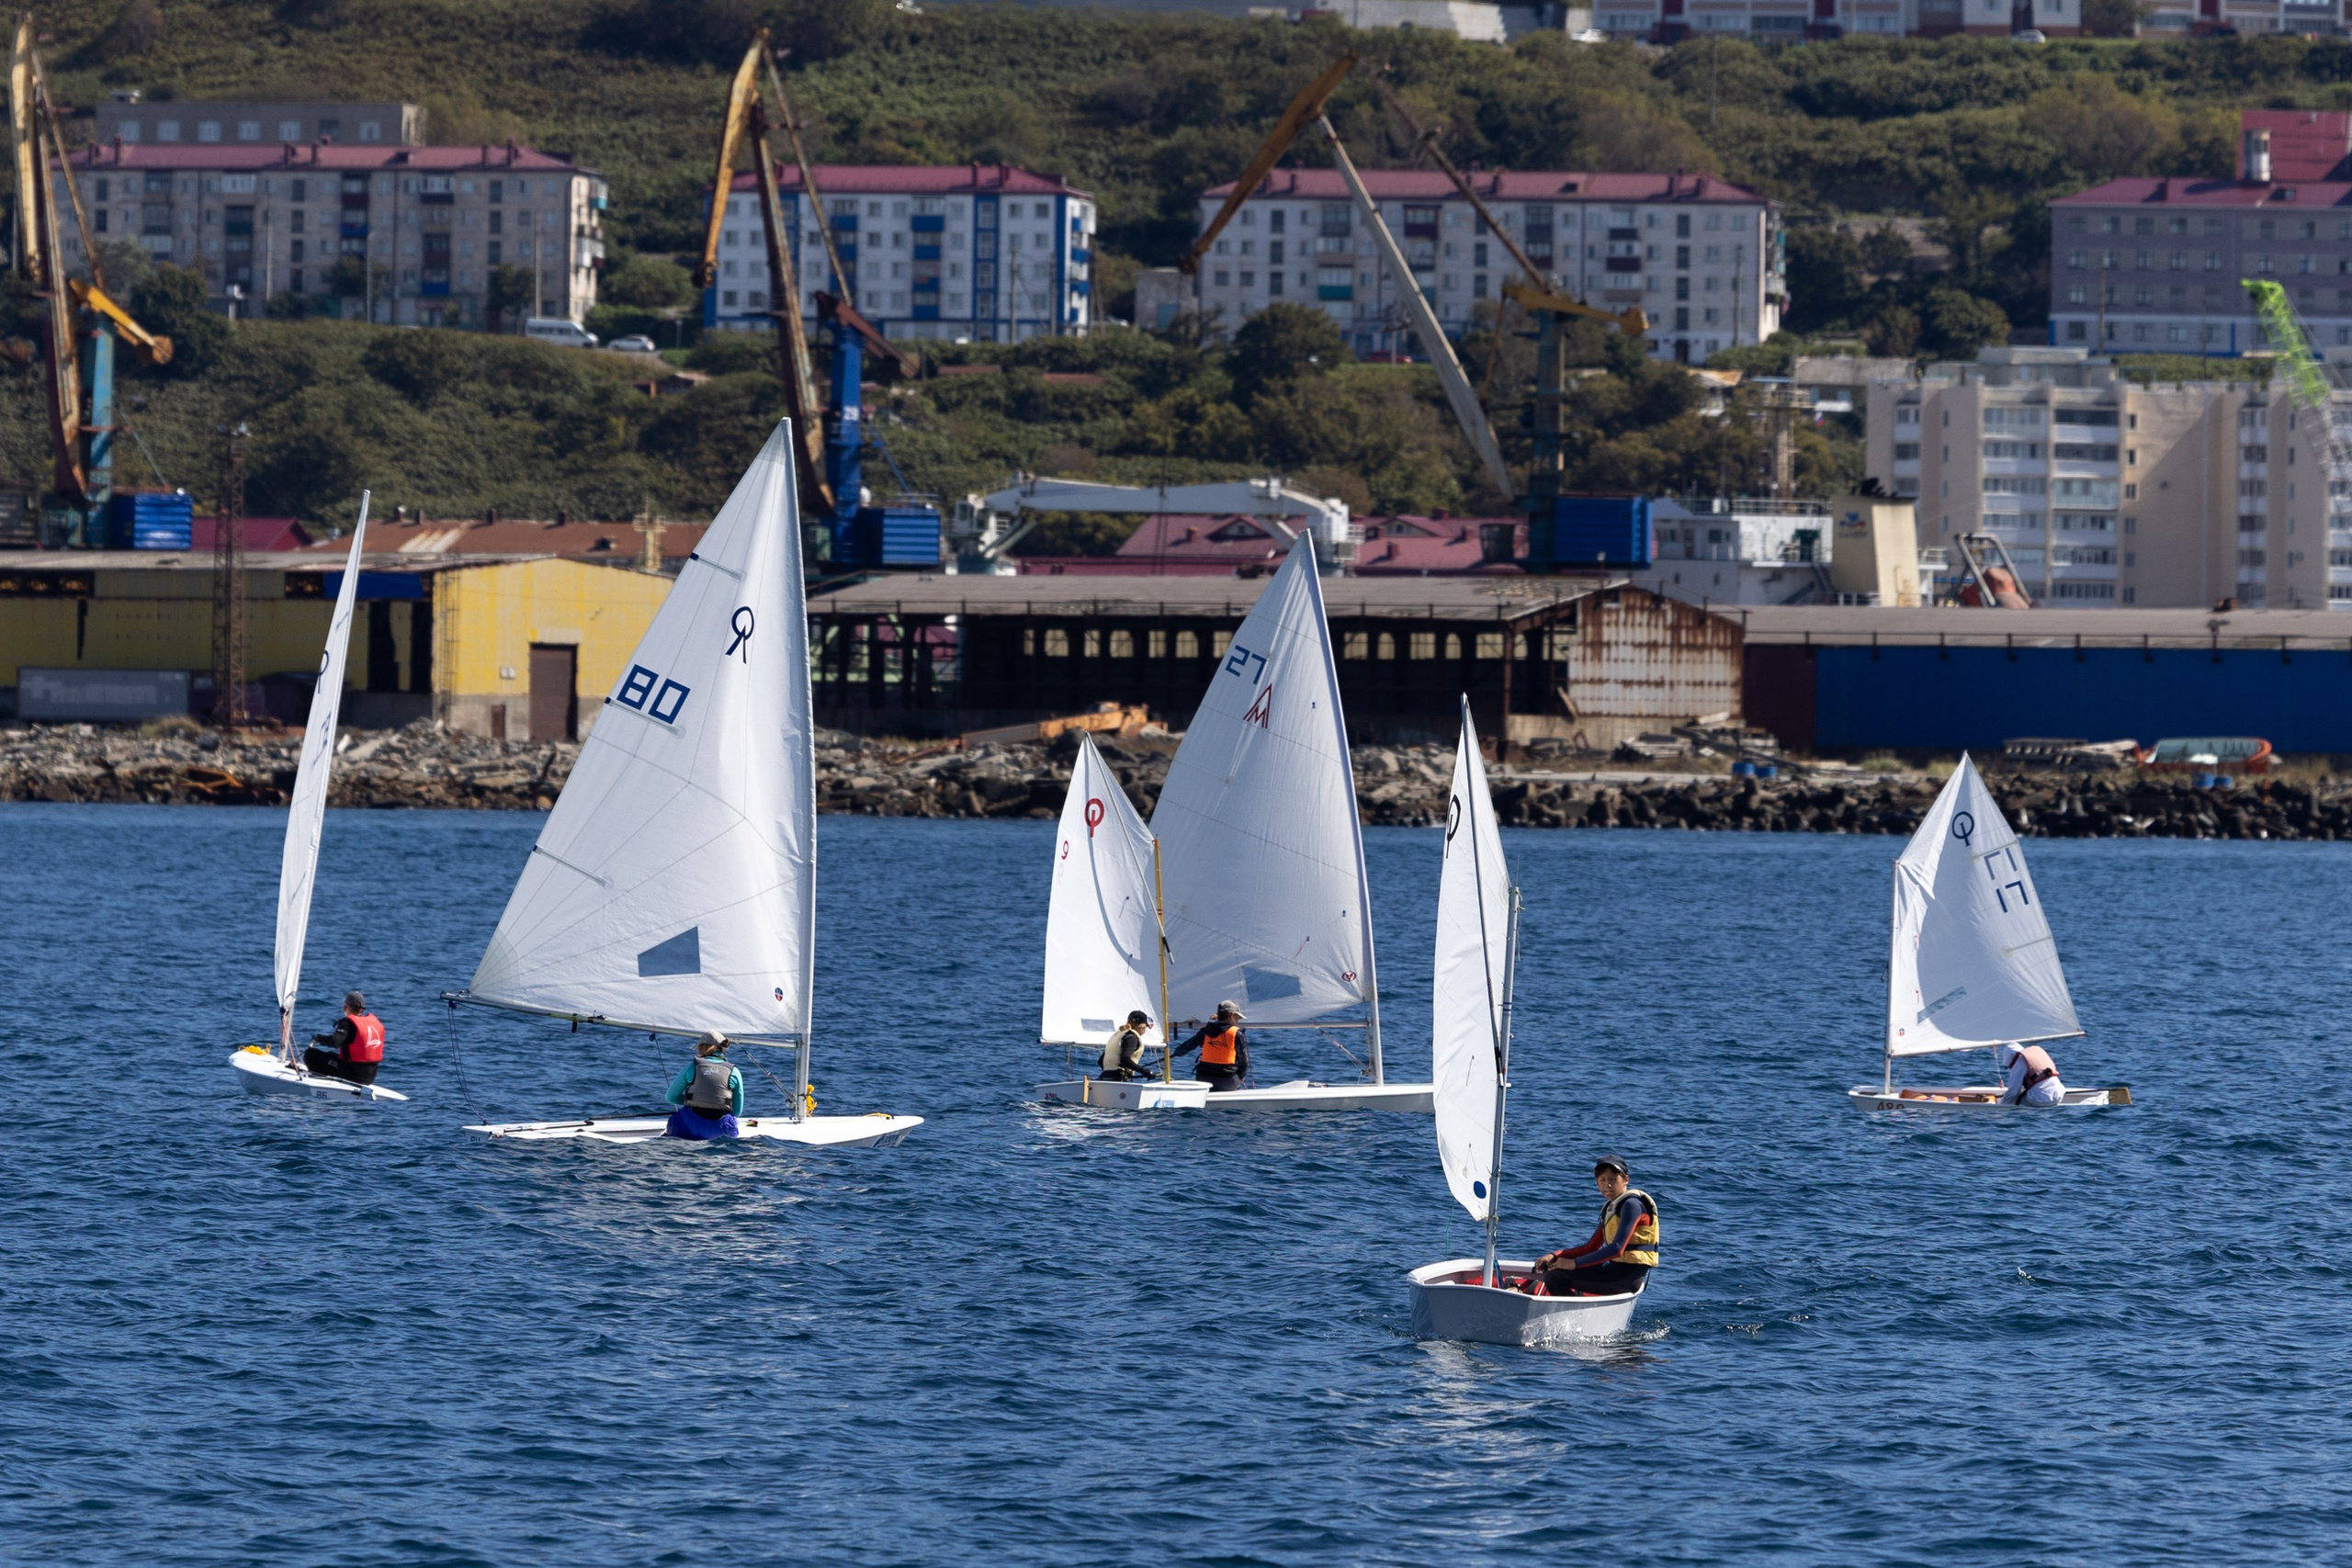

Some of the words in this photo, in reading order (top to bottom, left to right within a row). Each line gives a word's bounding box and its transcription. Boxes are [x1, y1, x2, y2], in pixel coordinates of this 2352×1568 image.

[843, 406, 859, 421] 29
[1225, 645, 1268, 685] 27
[616, 663, 691, 725] 80
[1061, 840, 1069, 860] 9
[1996, 880, 2030, 913] 17
